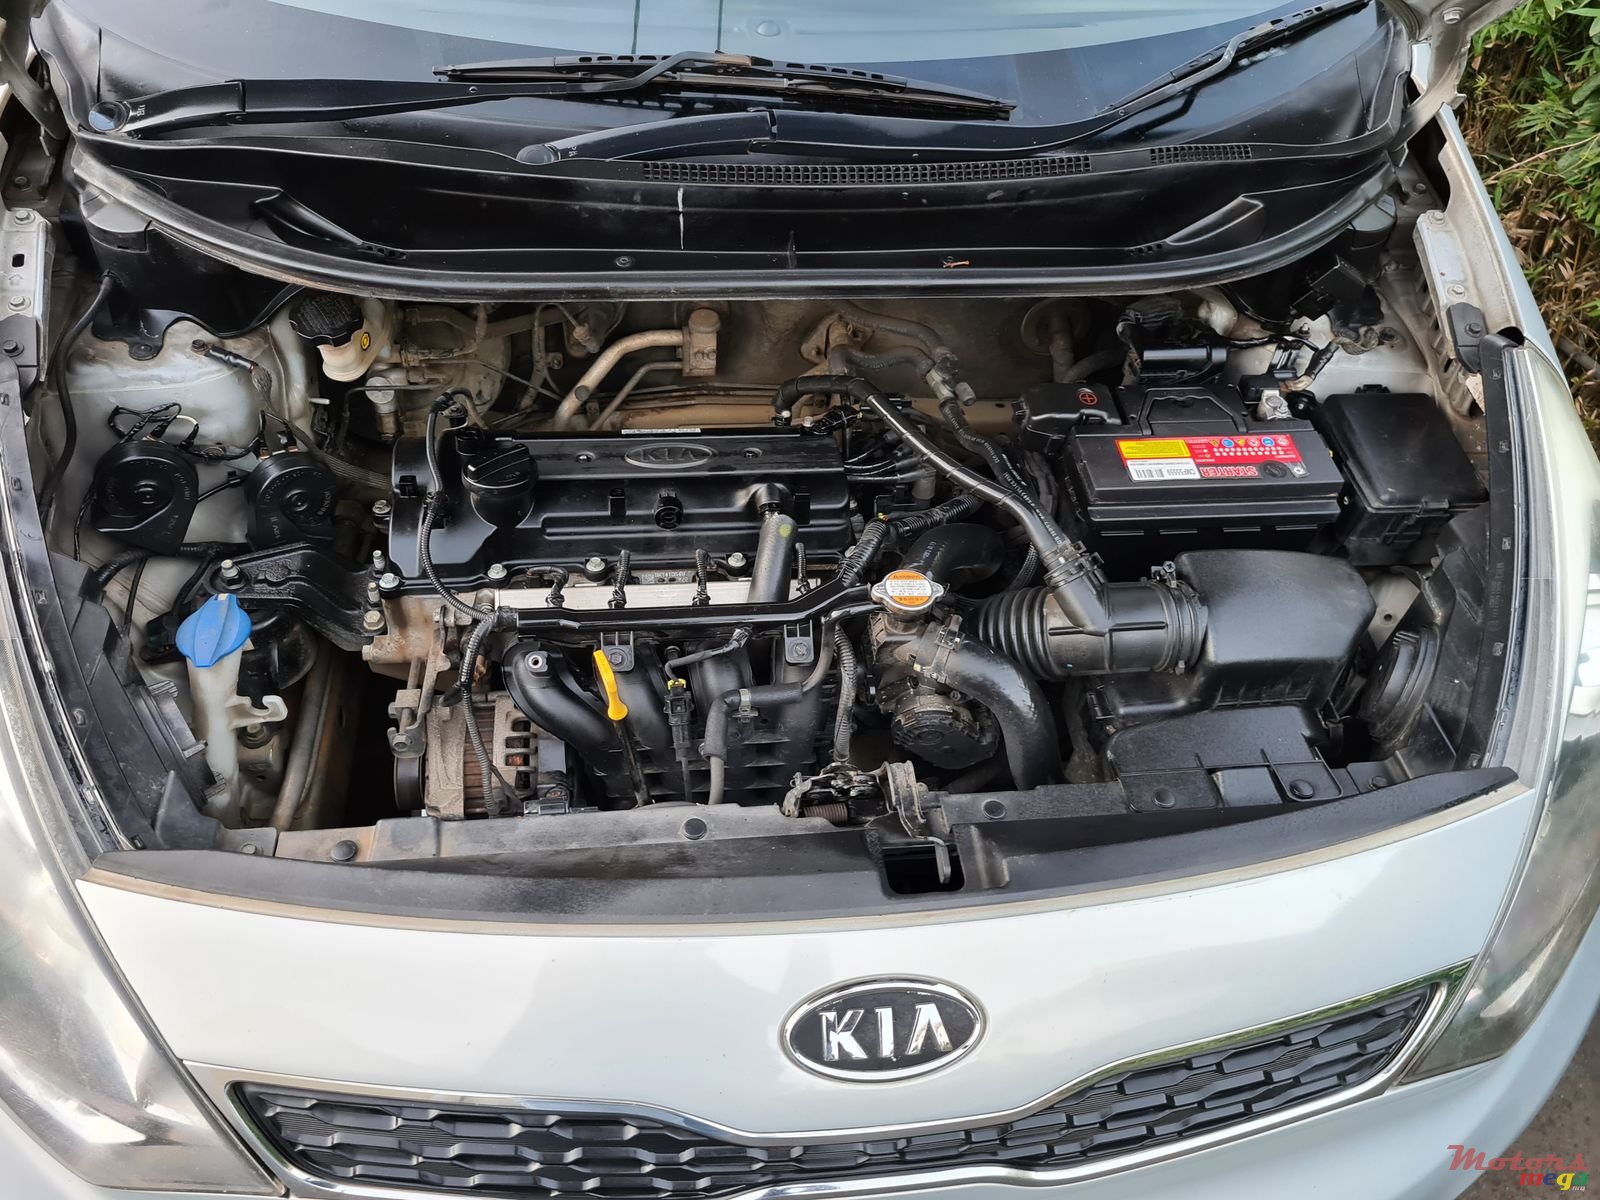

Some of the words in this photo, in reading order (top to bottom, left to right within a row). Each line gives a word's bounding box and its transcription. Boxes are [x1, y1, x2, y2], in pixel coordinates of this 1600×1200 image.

[640, 447, 700, 462] KIA
[1199, 465, 1257, 478] STARTER
[818, 1002, 953, 1062] KIA
